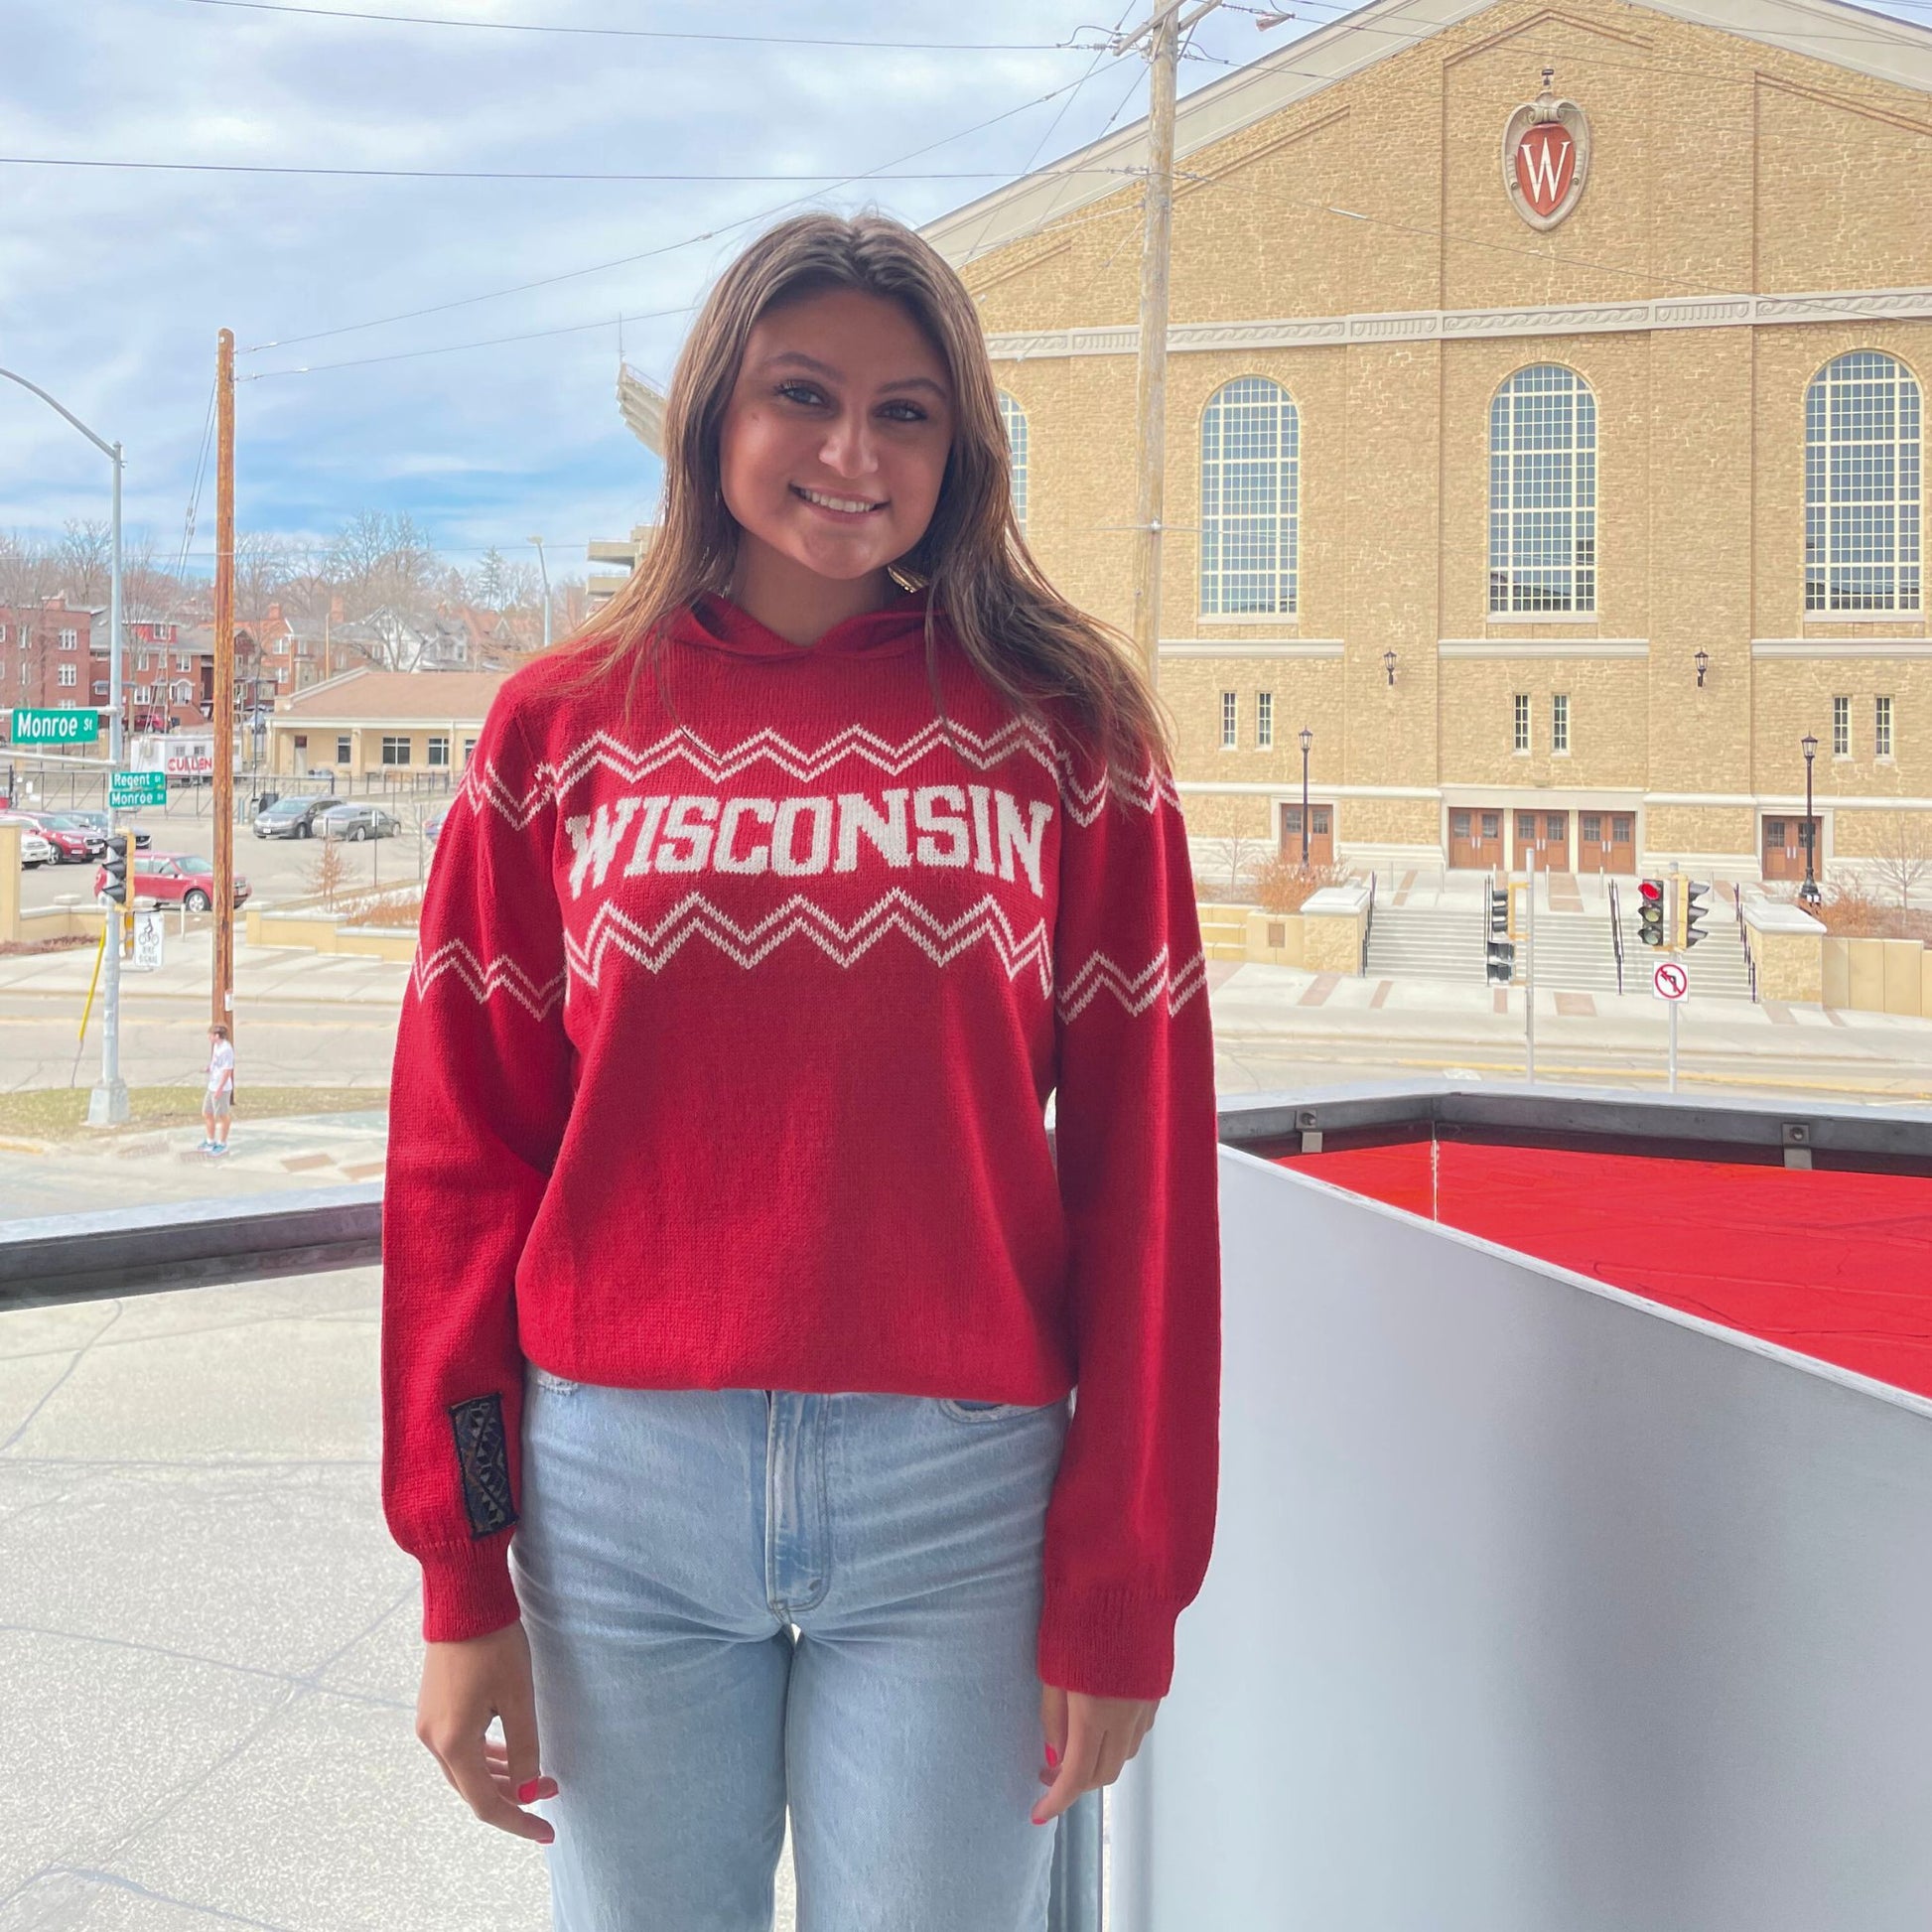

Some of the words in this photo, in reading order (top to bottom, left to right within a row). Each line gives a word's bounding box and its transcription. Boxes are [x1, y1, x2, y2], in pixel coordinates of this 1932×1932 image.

[1521, 137, 1572, 204] W
[18, 712, 77, 738] Monroe
[83, 718, 92, 731] St
[114, 774, 150, 789] Regent
[112, 792, 153, 805] Monroe
[565, 784, 1053, 900] WISCONSIN
